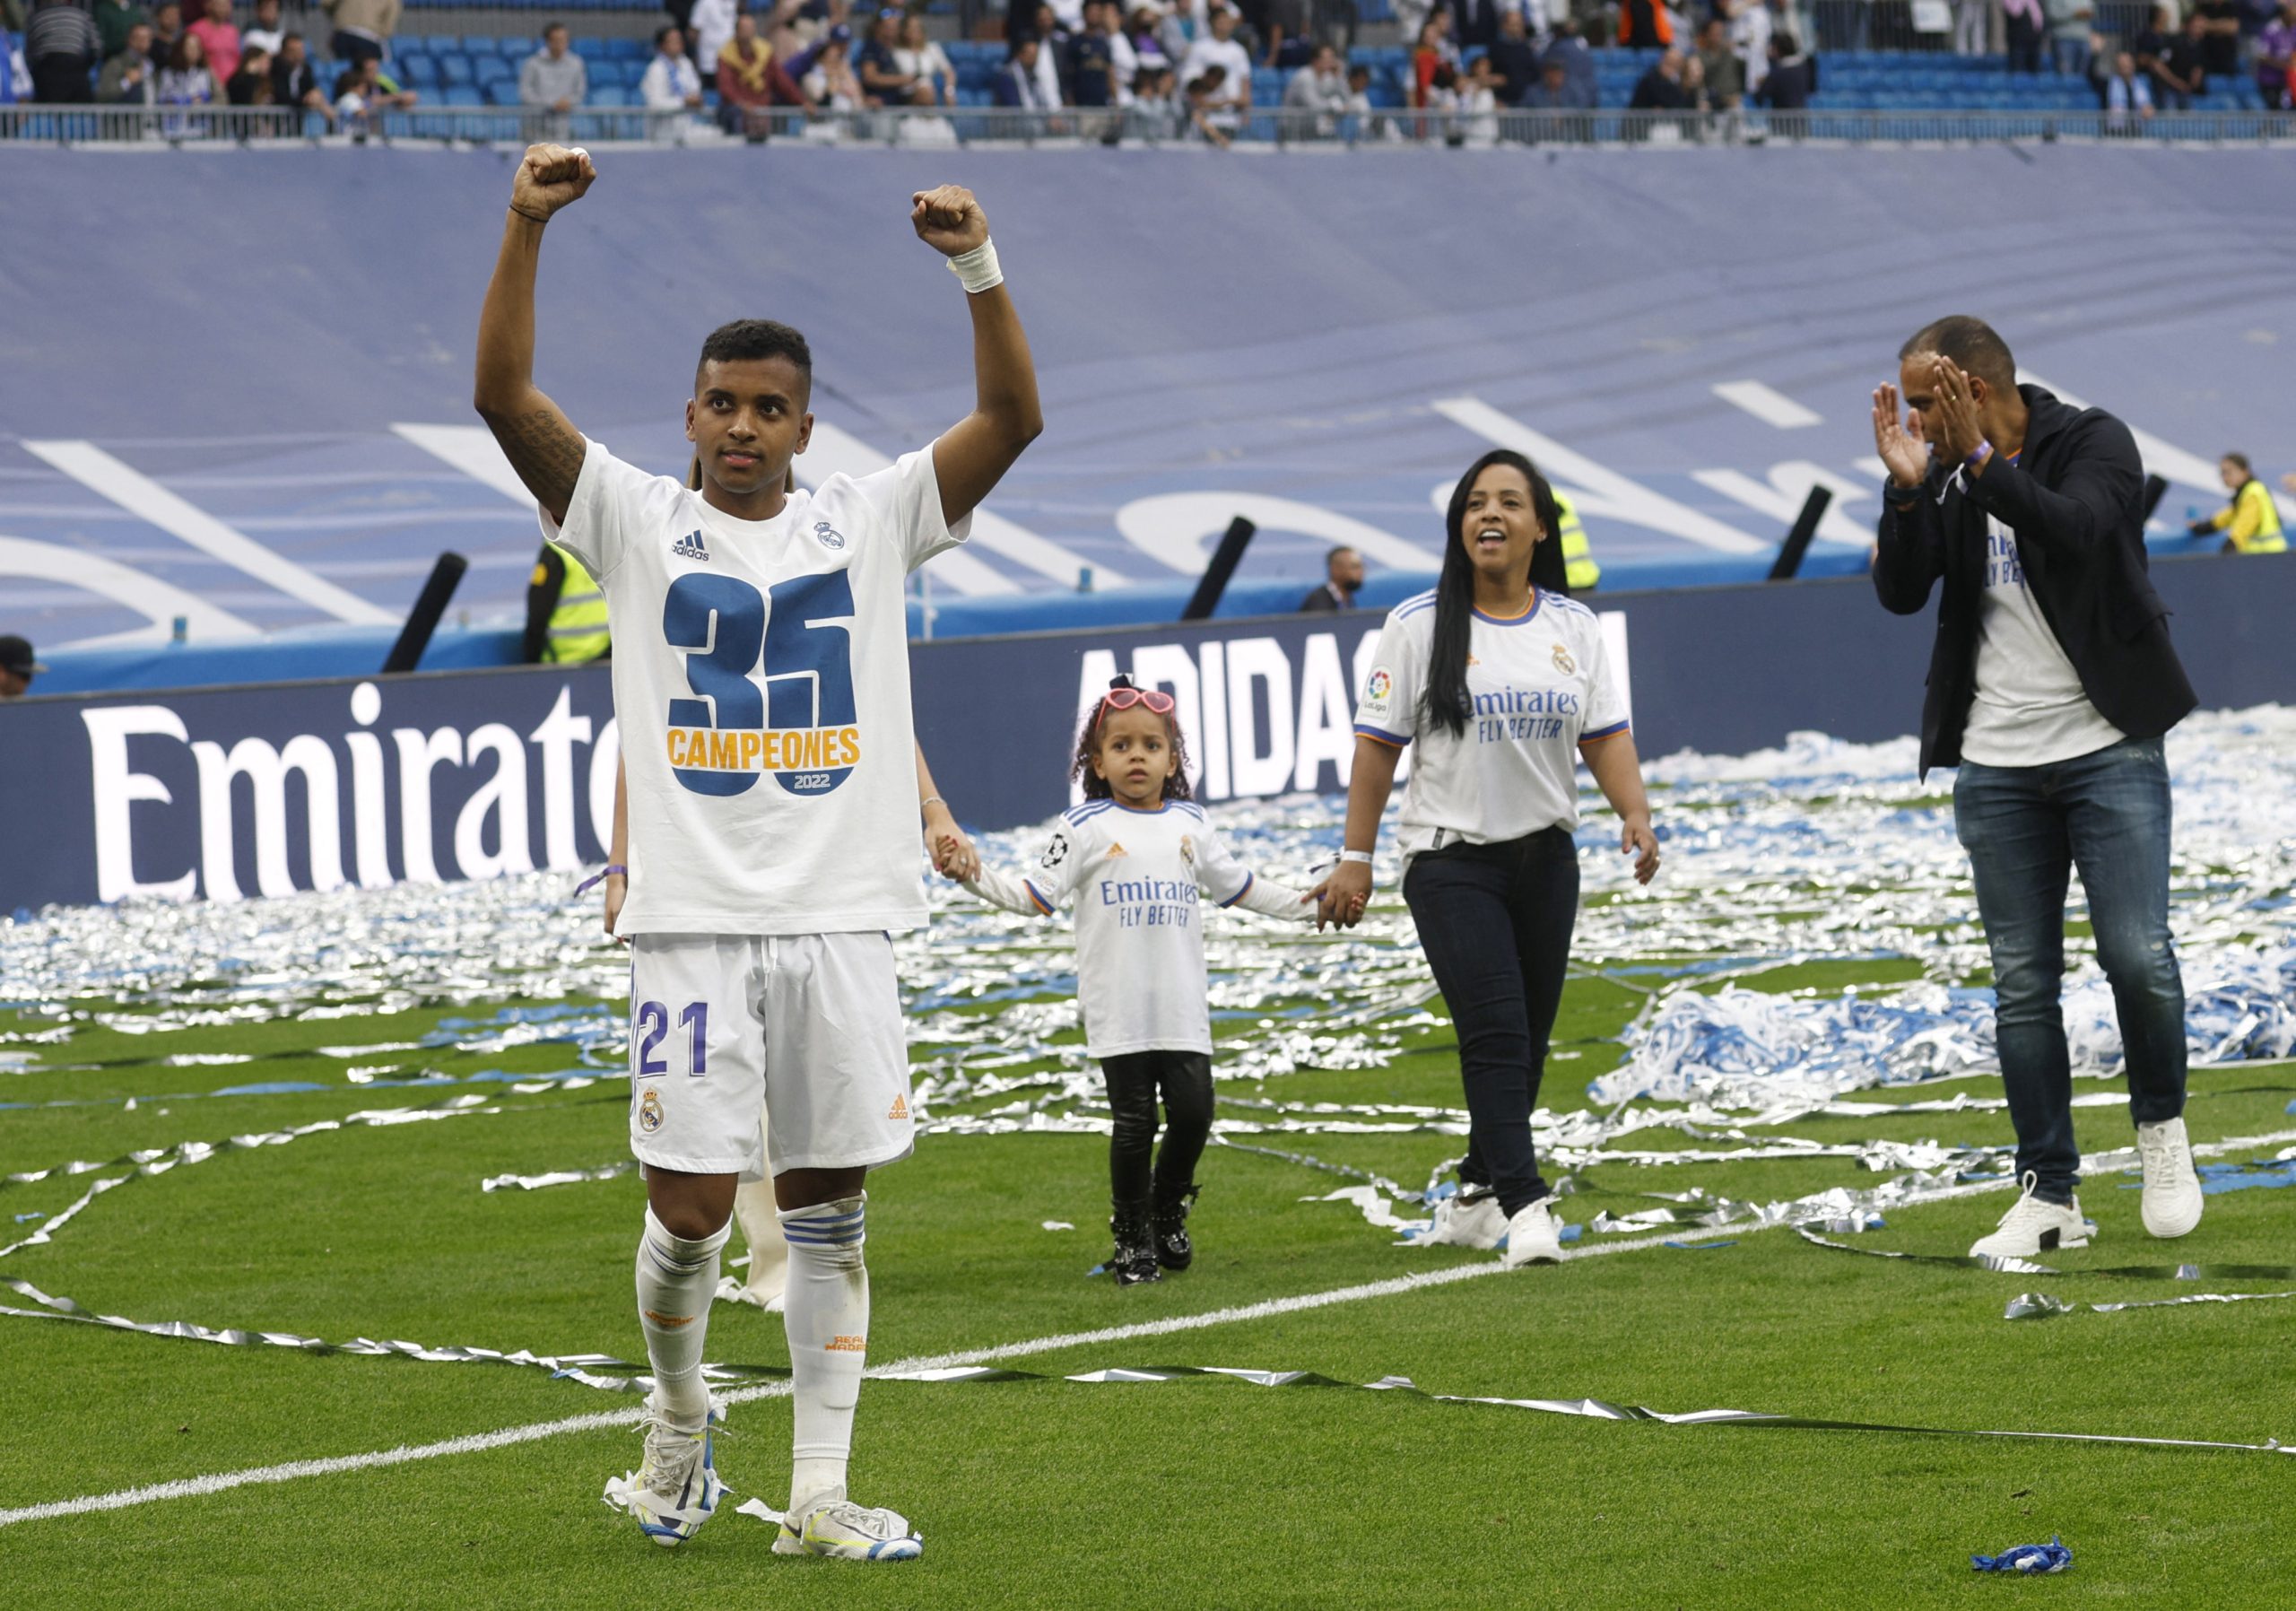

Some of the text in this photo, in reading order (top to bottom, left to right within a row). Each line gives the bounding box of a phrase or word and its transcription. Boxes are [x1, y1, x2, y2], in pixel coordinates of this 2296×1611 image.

[672, 544, 709, 562] adidas
[663, 568, 858, 797] 35
[1479, 718, 1563, 744] FLY BETTER
[666, 727, 860, 769] CAMPEONES
[794, 773, 831, 789] 2022
[1100, 875, 1198, 906] Emirates
[1120, 904, 1188, 927] FLY BETTER
[638, 1000, 709, 1079] 21
[834, 1336, 865, 1344] REAL
